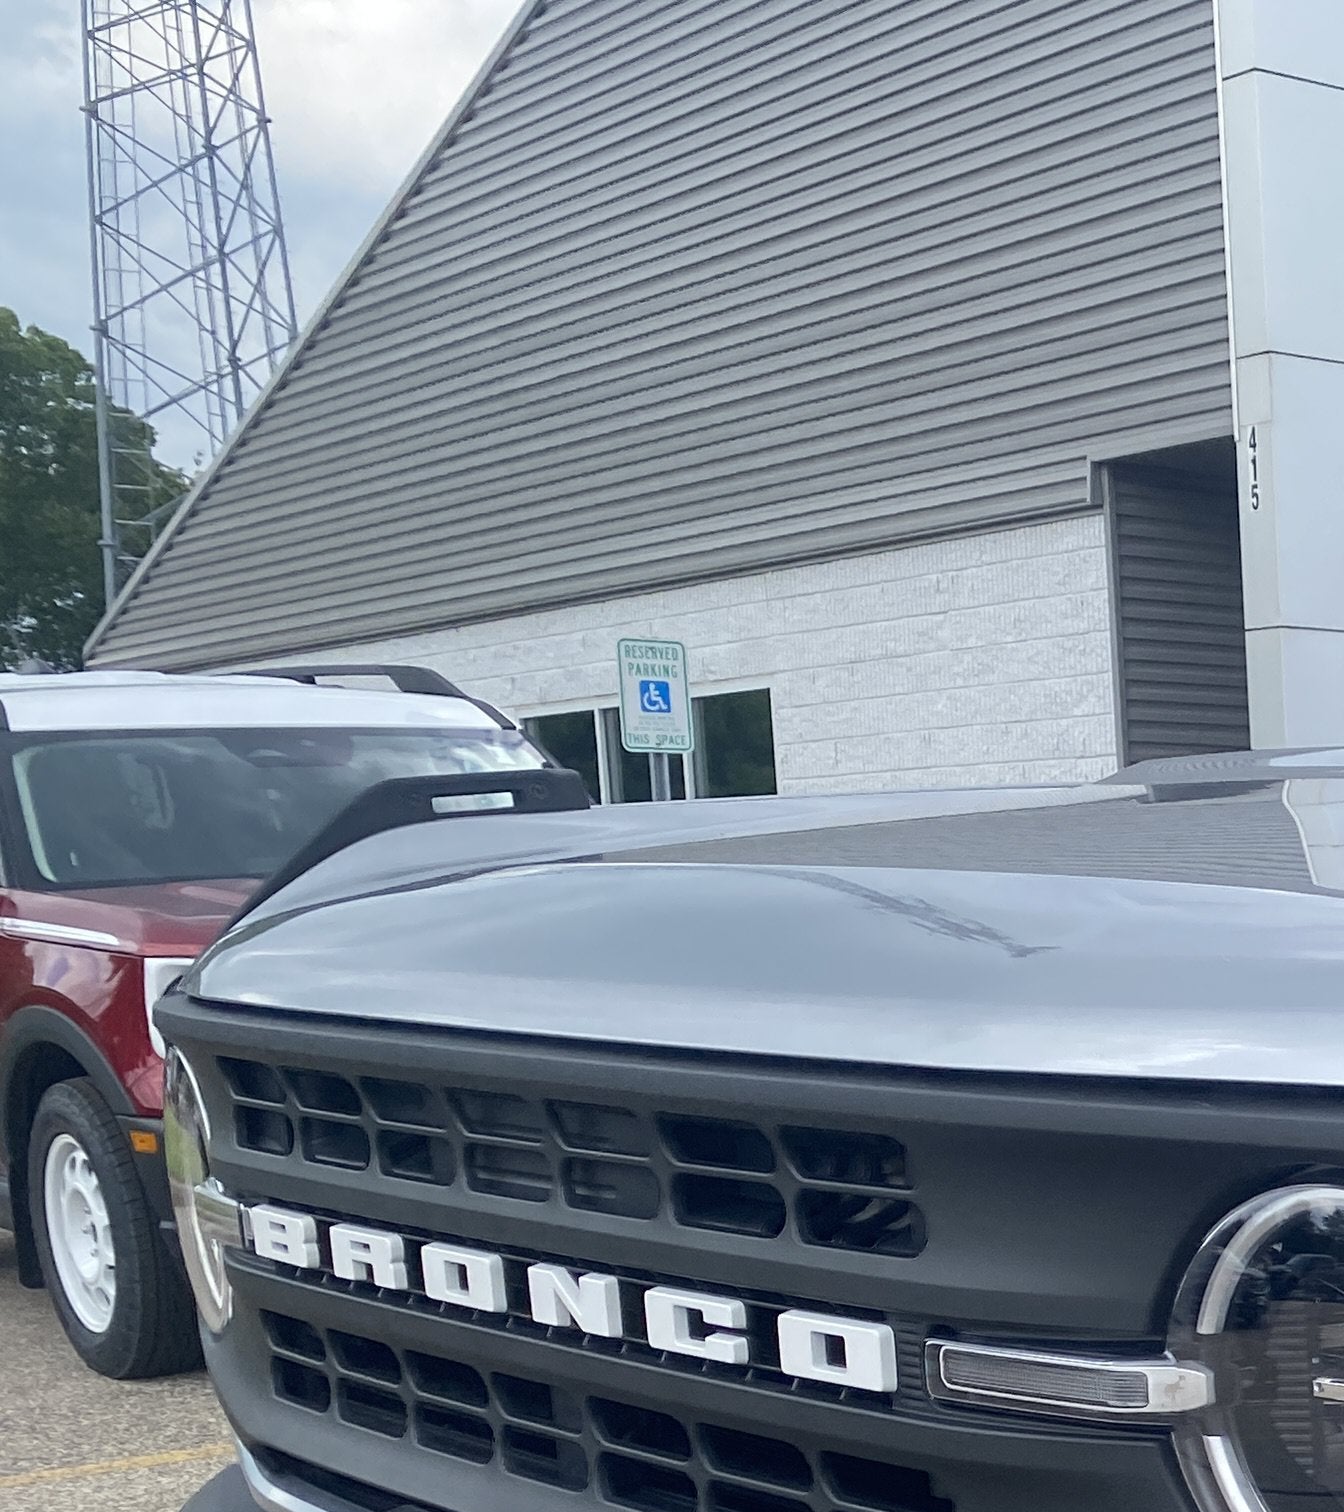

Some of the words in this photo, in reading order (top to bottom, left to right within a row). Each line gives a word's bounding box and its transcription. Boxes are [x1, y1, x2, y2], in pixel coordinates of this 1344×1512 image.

[1249, 426, 1259, 510] 415
[624, 644, 679, 661] RESERVED
[627, 662, 678, 678] PARKING
[627, 733, 650, 745] THIS
[655, 734, 686, 746] SPACE
[252, 1203, 898, 1393] BRONCO
